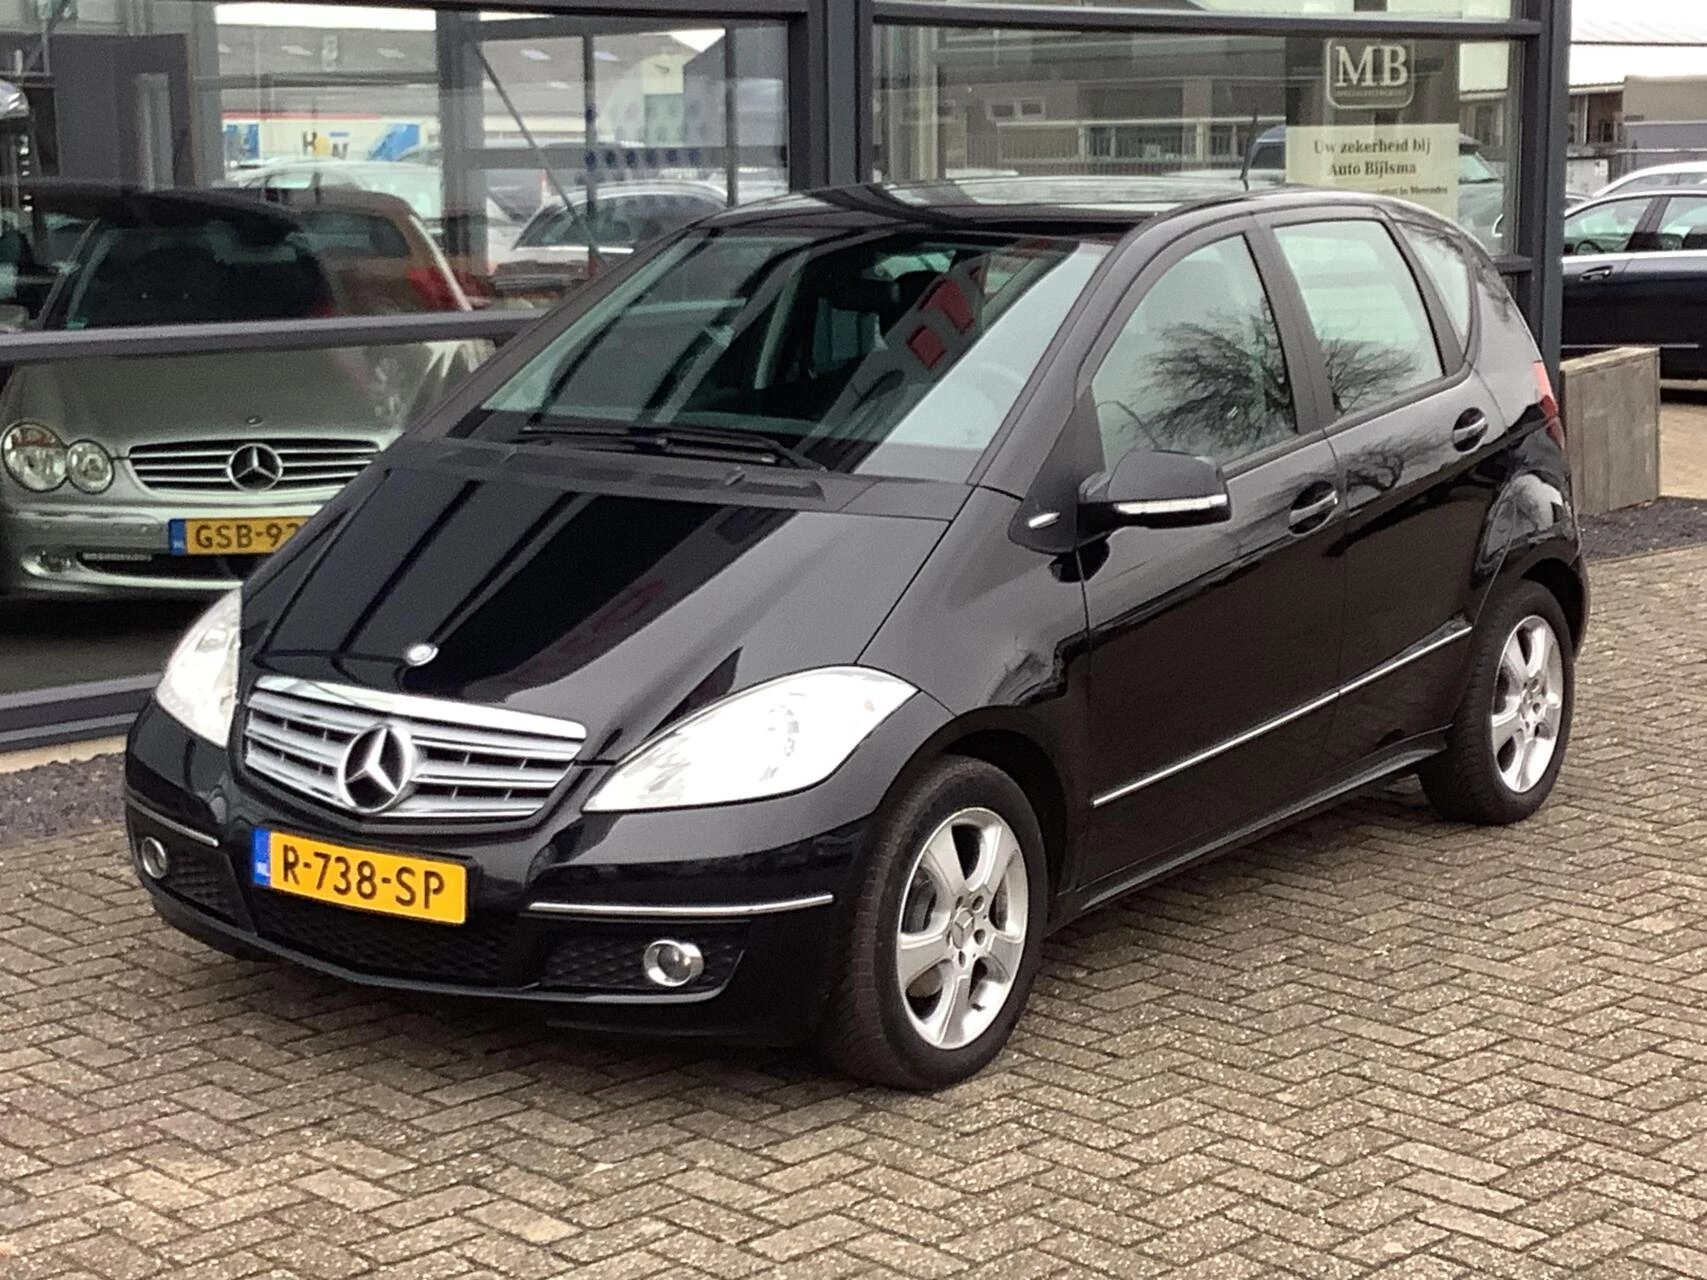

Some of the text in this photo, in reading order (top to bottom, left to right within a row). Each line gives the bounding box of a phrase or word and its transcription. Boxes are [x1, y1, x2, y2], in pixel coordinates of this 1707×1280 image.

[1334, 45, 1408, 87] MB
[1314, 138, 1431, 156] Uw zekerheid bij
[1330, 161, 1417, 180] Auto Bijlsma
[282, 843, 446, 910] R-738-SP
